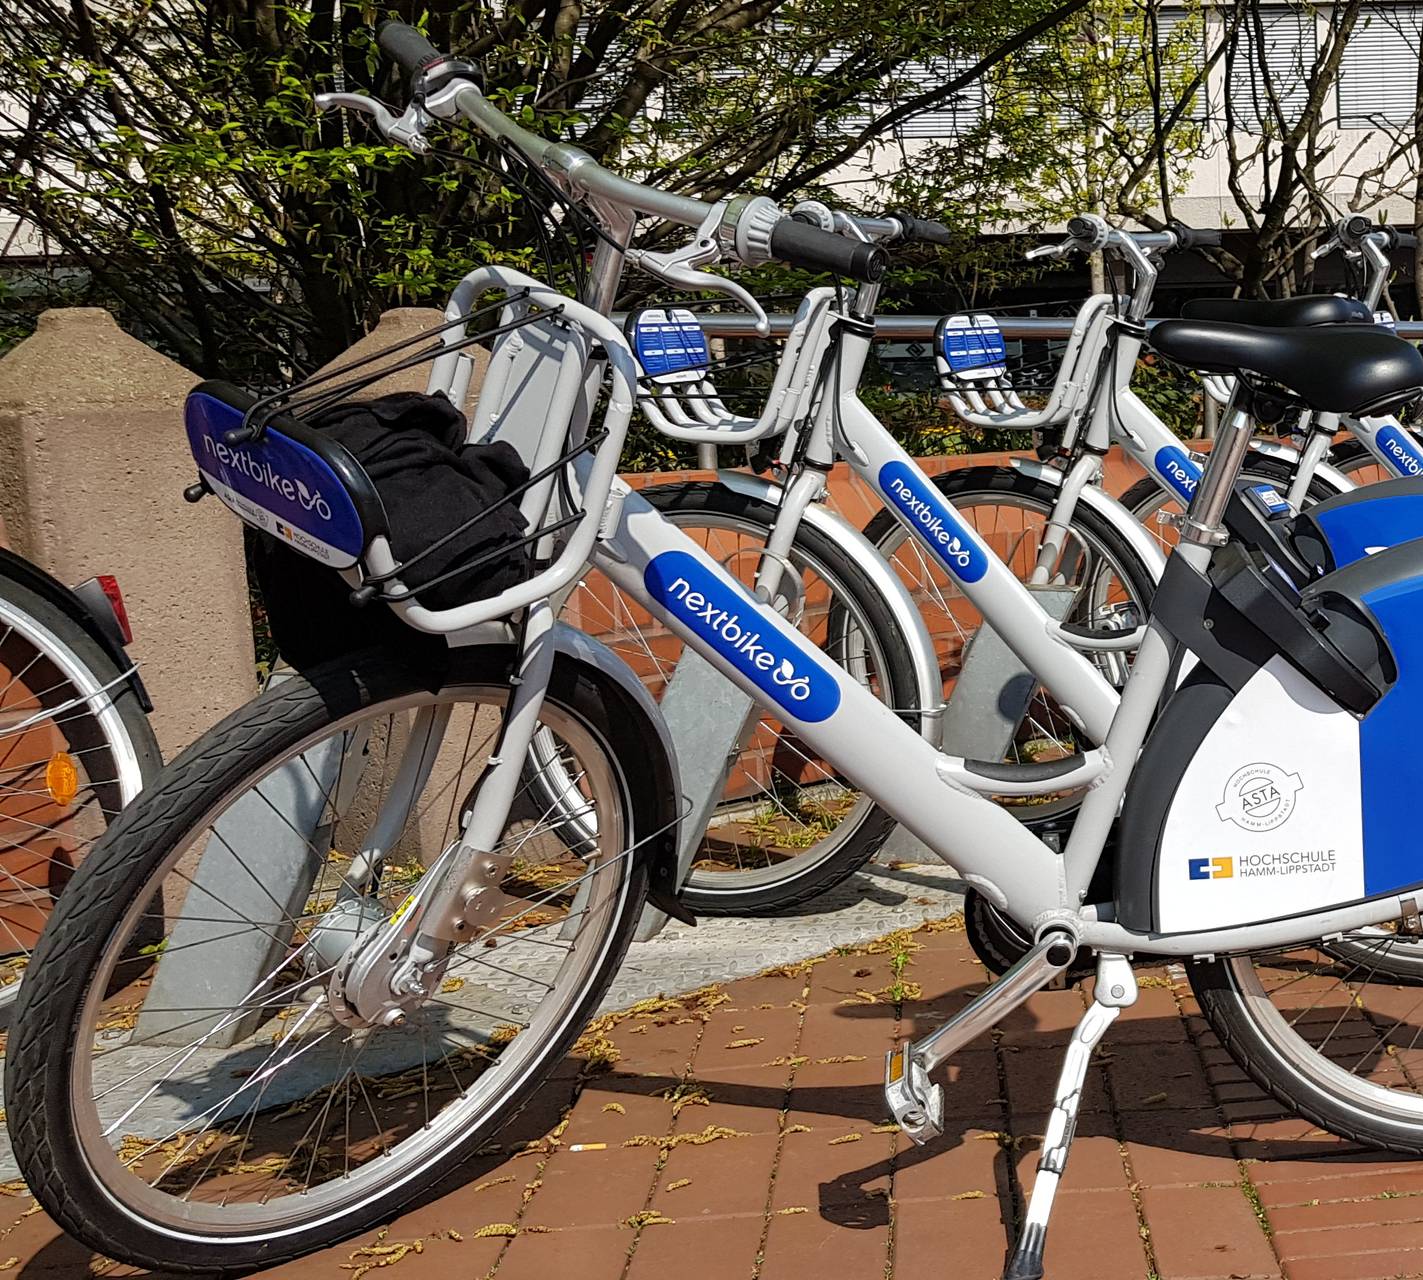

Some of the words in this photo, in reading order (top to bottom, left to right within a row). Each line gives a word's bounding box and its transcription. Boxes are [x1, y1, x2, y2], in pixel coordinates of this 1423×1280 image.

[203, 434, 296, 501] nextbike
[1166, 460, 1197, 493] next
[891, 478, 950, 545] nextbike
[668, 578, 775, 671] nextbike
[1242, 786, 1281, 810] ASTA
[1239, 850, 1336, 867] HOCHSCHULE
[1240, 862, 1337, 878] HAMM-LIPPSTADT
